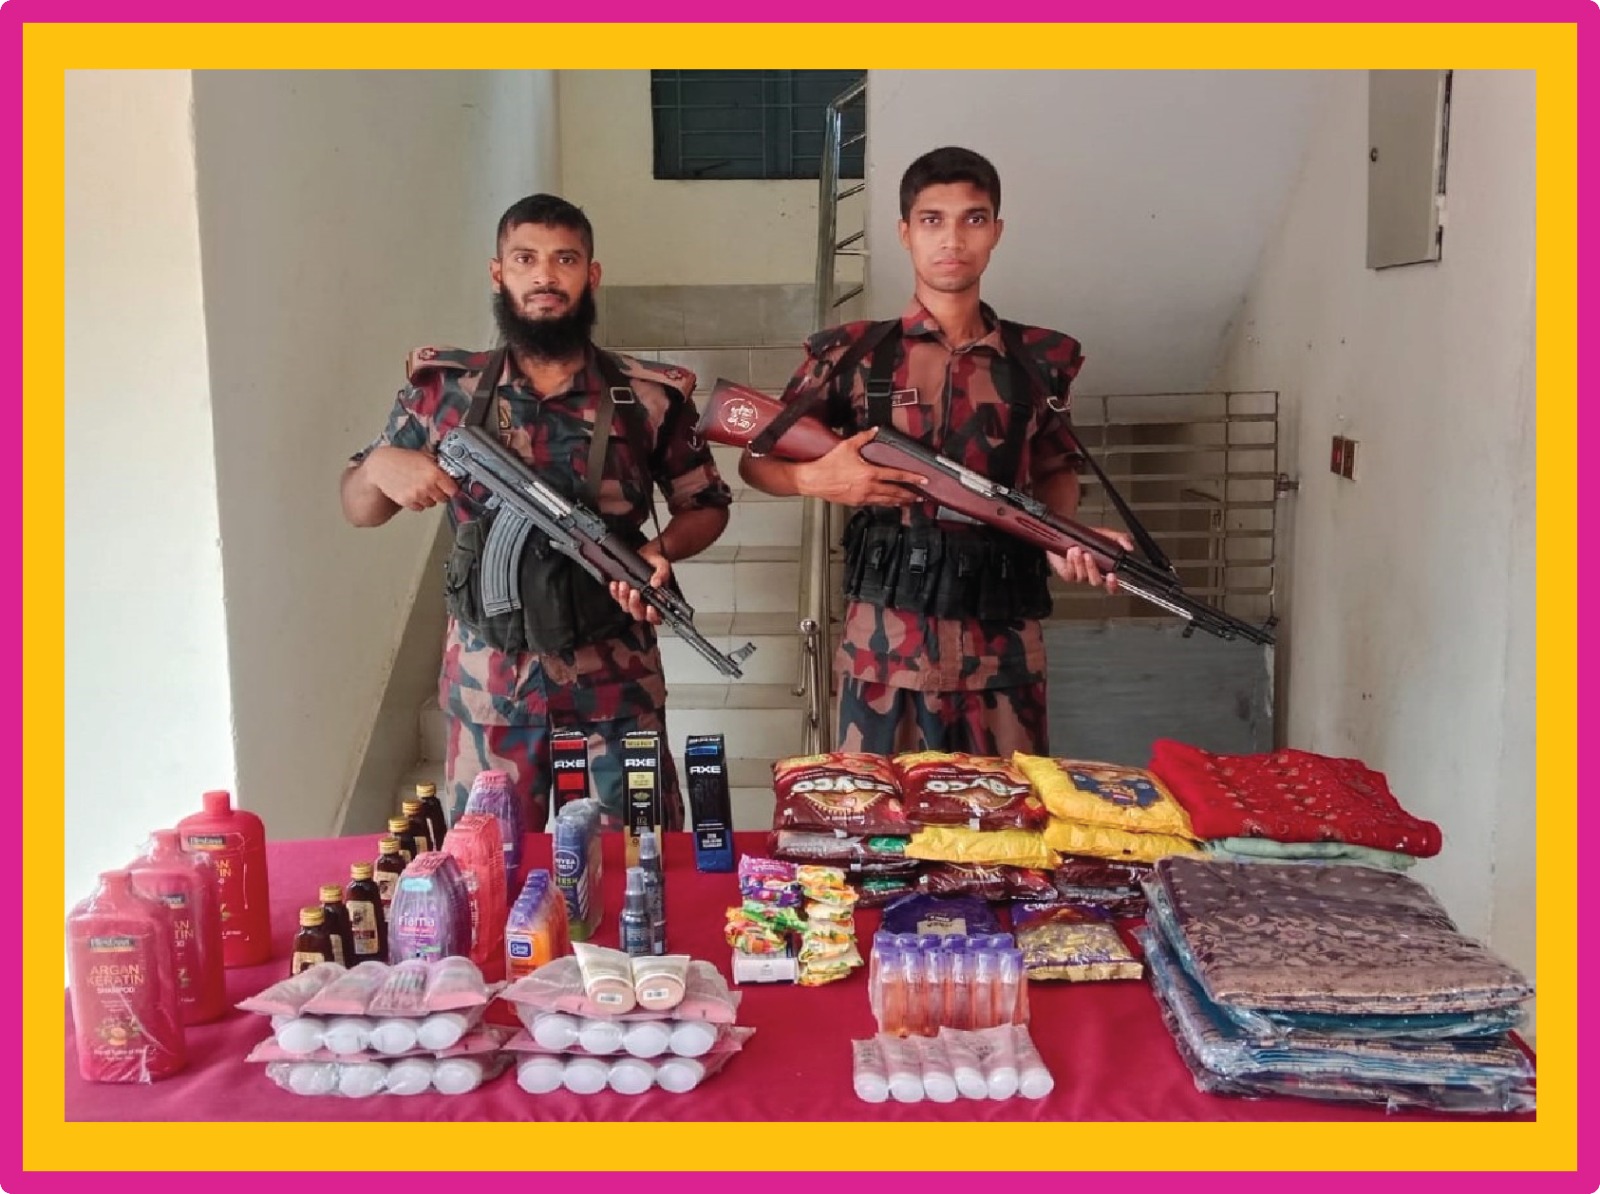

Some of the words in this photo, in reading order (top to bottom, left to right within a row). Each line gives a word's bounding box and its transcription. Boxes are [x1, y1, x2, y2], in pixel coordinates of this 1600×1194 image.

[554, 759, 585, 769] AXE
[625, 758, 656, 768] AXE
[690, 765, 721, 775] AXE
[90, 964, 140, 975] ARGAN
[89, 974, 145, 986] KERATIN
